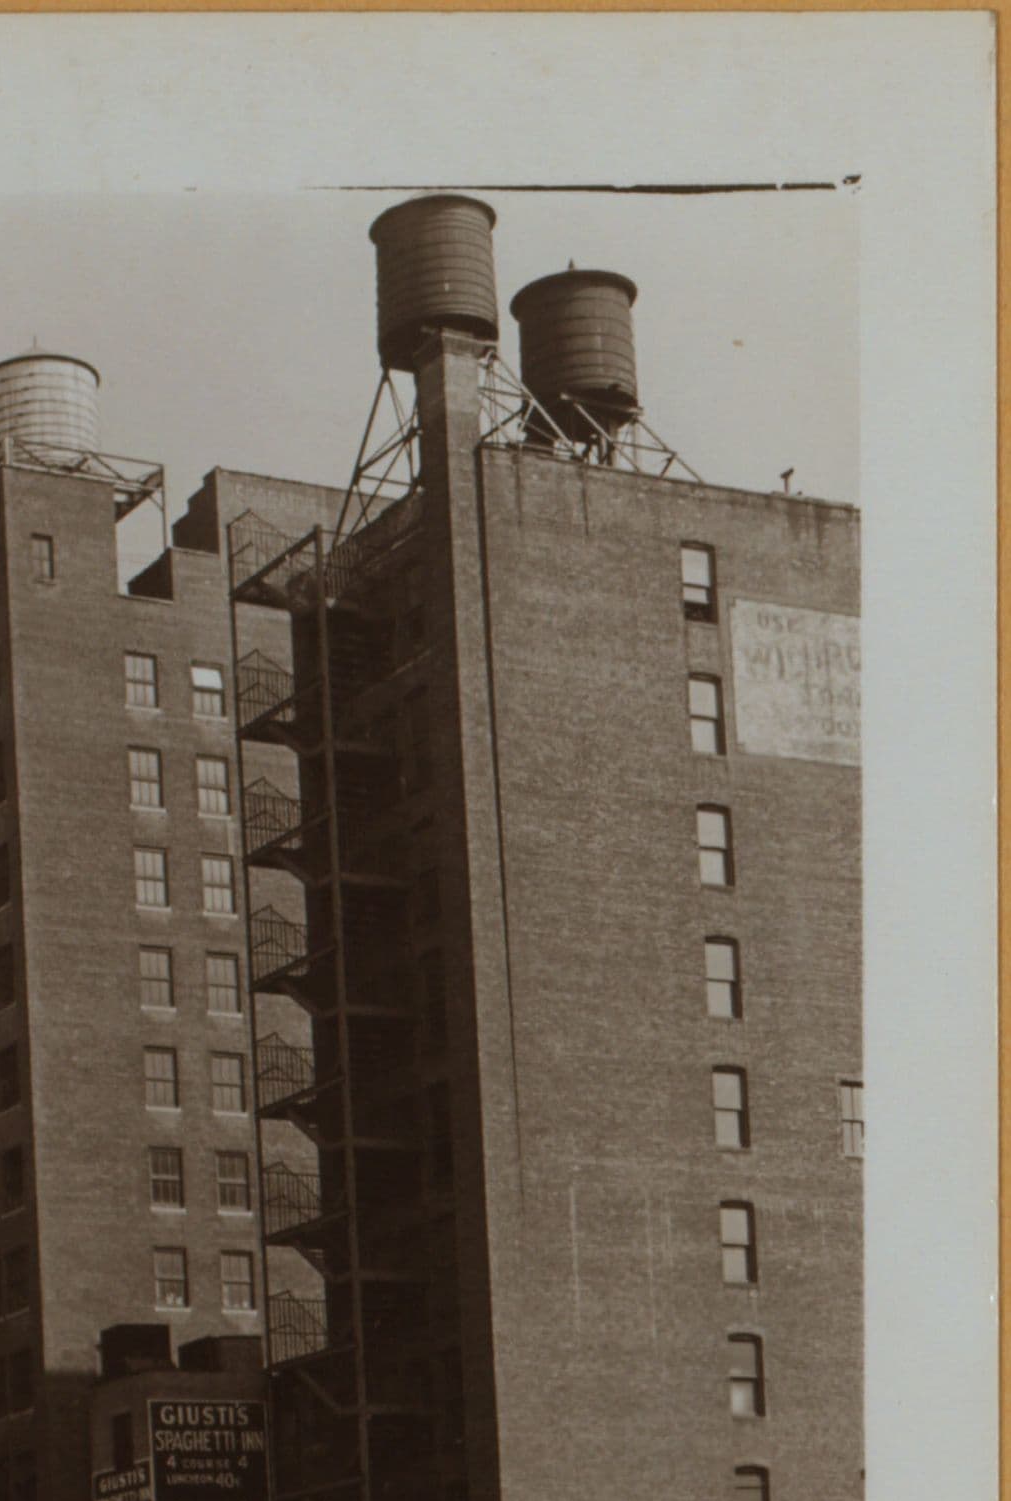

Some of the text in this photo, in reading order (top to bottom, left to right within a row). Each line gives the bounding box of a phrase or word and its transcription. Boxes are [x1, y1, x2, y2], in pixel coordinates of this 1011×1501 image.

[154, 1429, 265, 1453] SPAGHETTI INN
[166, 1455, 178, 1470] 4
[237, 1455, 249, 1470] 4
